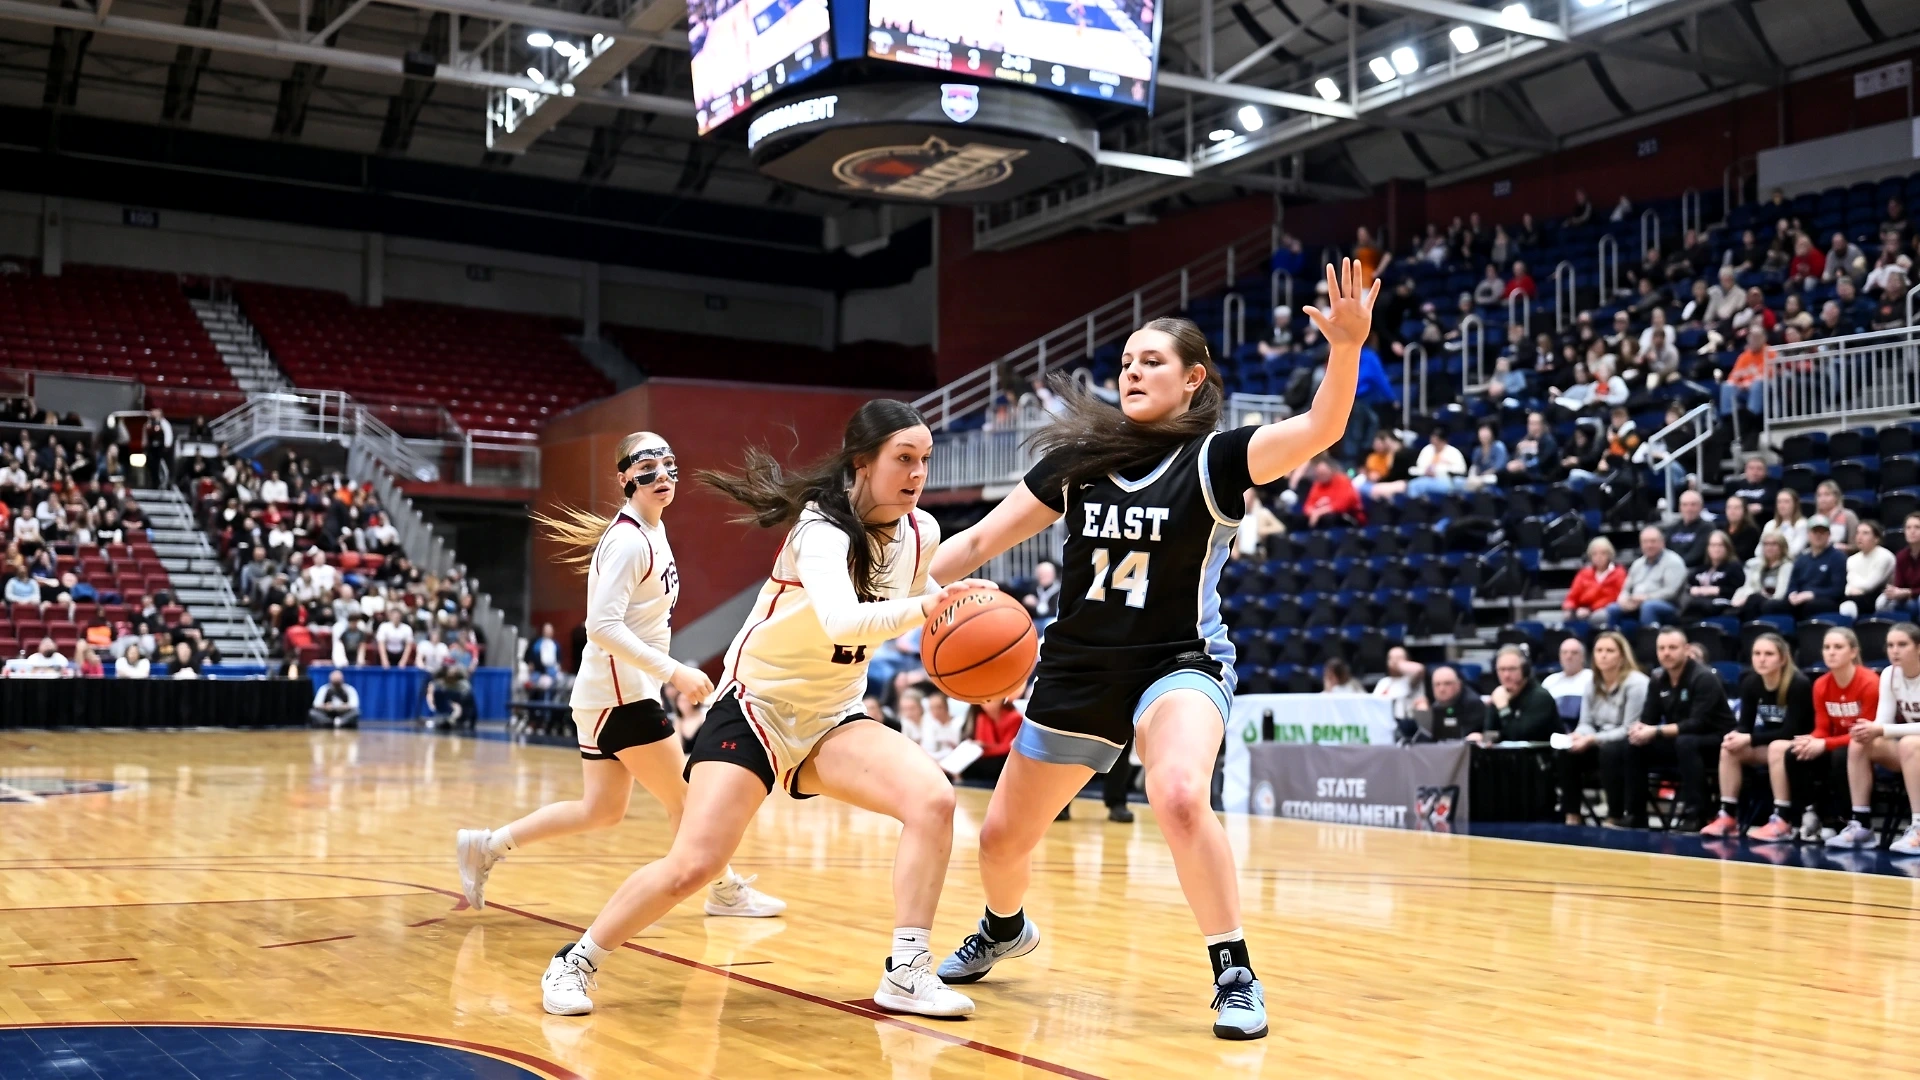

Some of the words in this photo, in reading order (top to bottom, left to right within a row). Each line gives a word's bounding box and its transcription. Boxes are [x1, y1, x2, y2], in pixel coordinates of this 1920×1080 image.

[1082, 502, 1170, 541] EAST
[1084, 548, 1151, 609] 14
[1316, 777, 1367, 798] STATE
